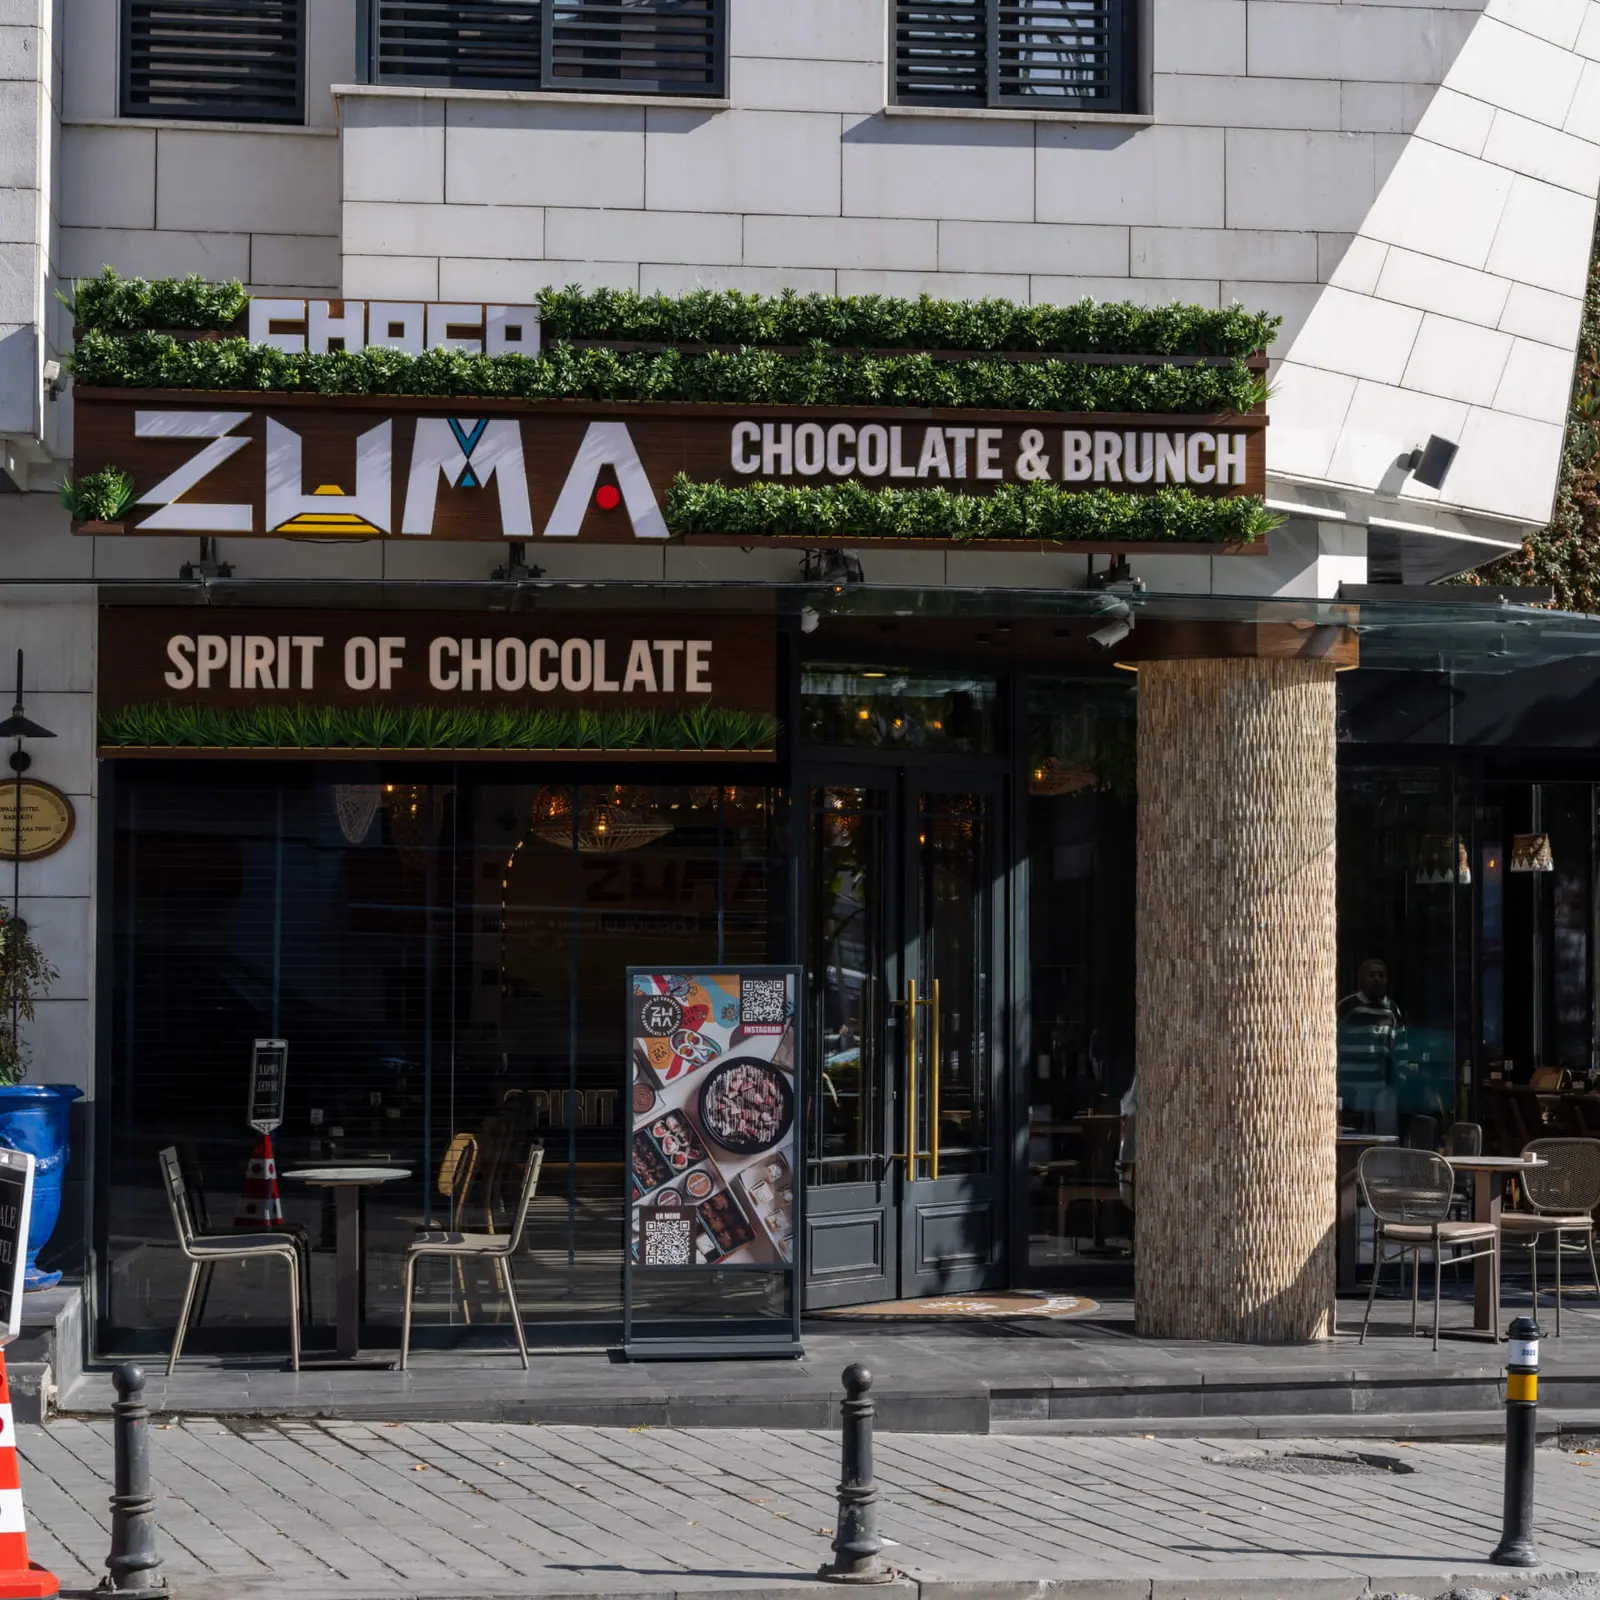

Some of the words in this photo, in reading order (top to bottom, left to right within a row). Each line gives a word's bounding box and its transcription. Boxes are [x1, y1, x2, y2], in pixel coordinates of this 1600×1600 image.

[249, 300, 541, 358] CHOCO
[134, 410, 670, 538] ZUMA
[731, 421, 1003, 480] CHOCOLATE
[1017, 429, 1050, 482] &
[1062, 430, 1247, 485] BRUNCH
[164, 635, 324, 689] SPIRIT
[344, 636, 406, 691] OF
[428, 636, 713, 693] CHOCOLATE
[743, 1026, 782, 1034] INSTAGRAM
[664, 1212, 681, 1220] MENU
